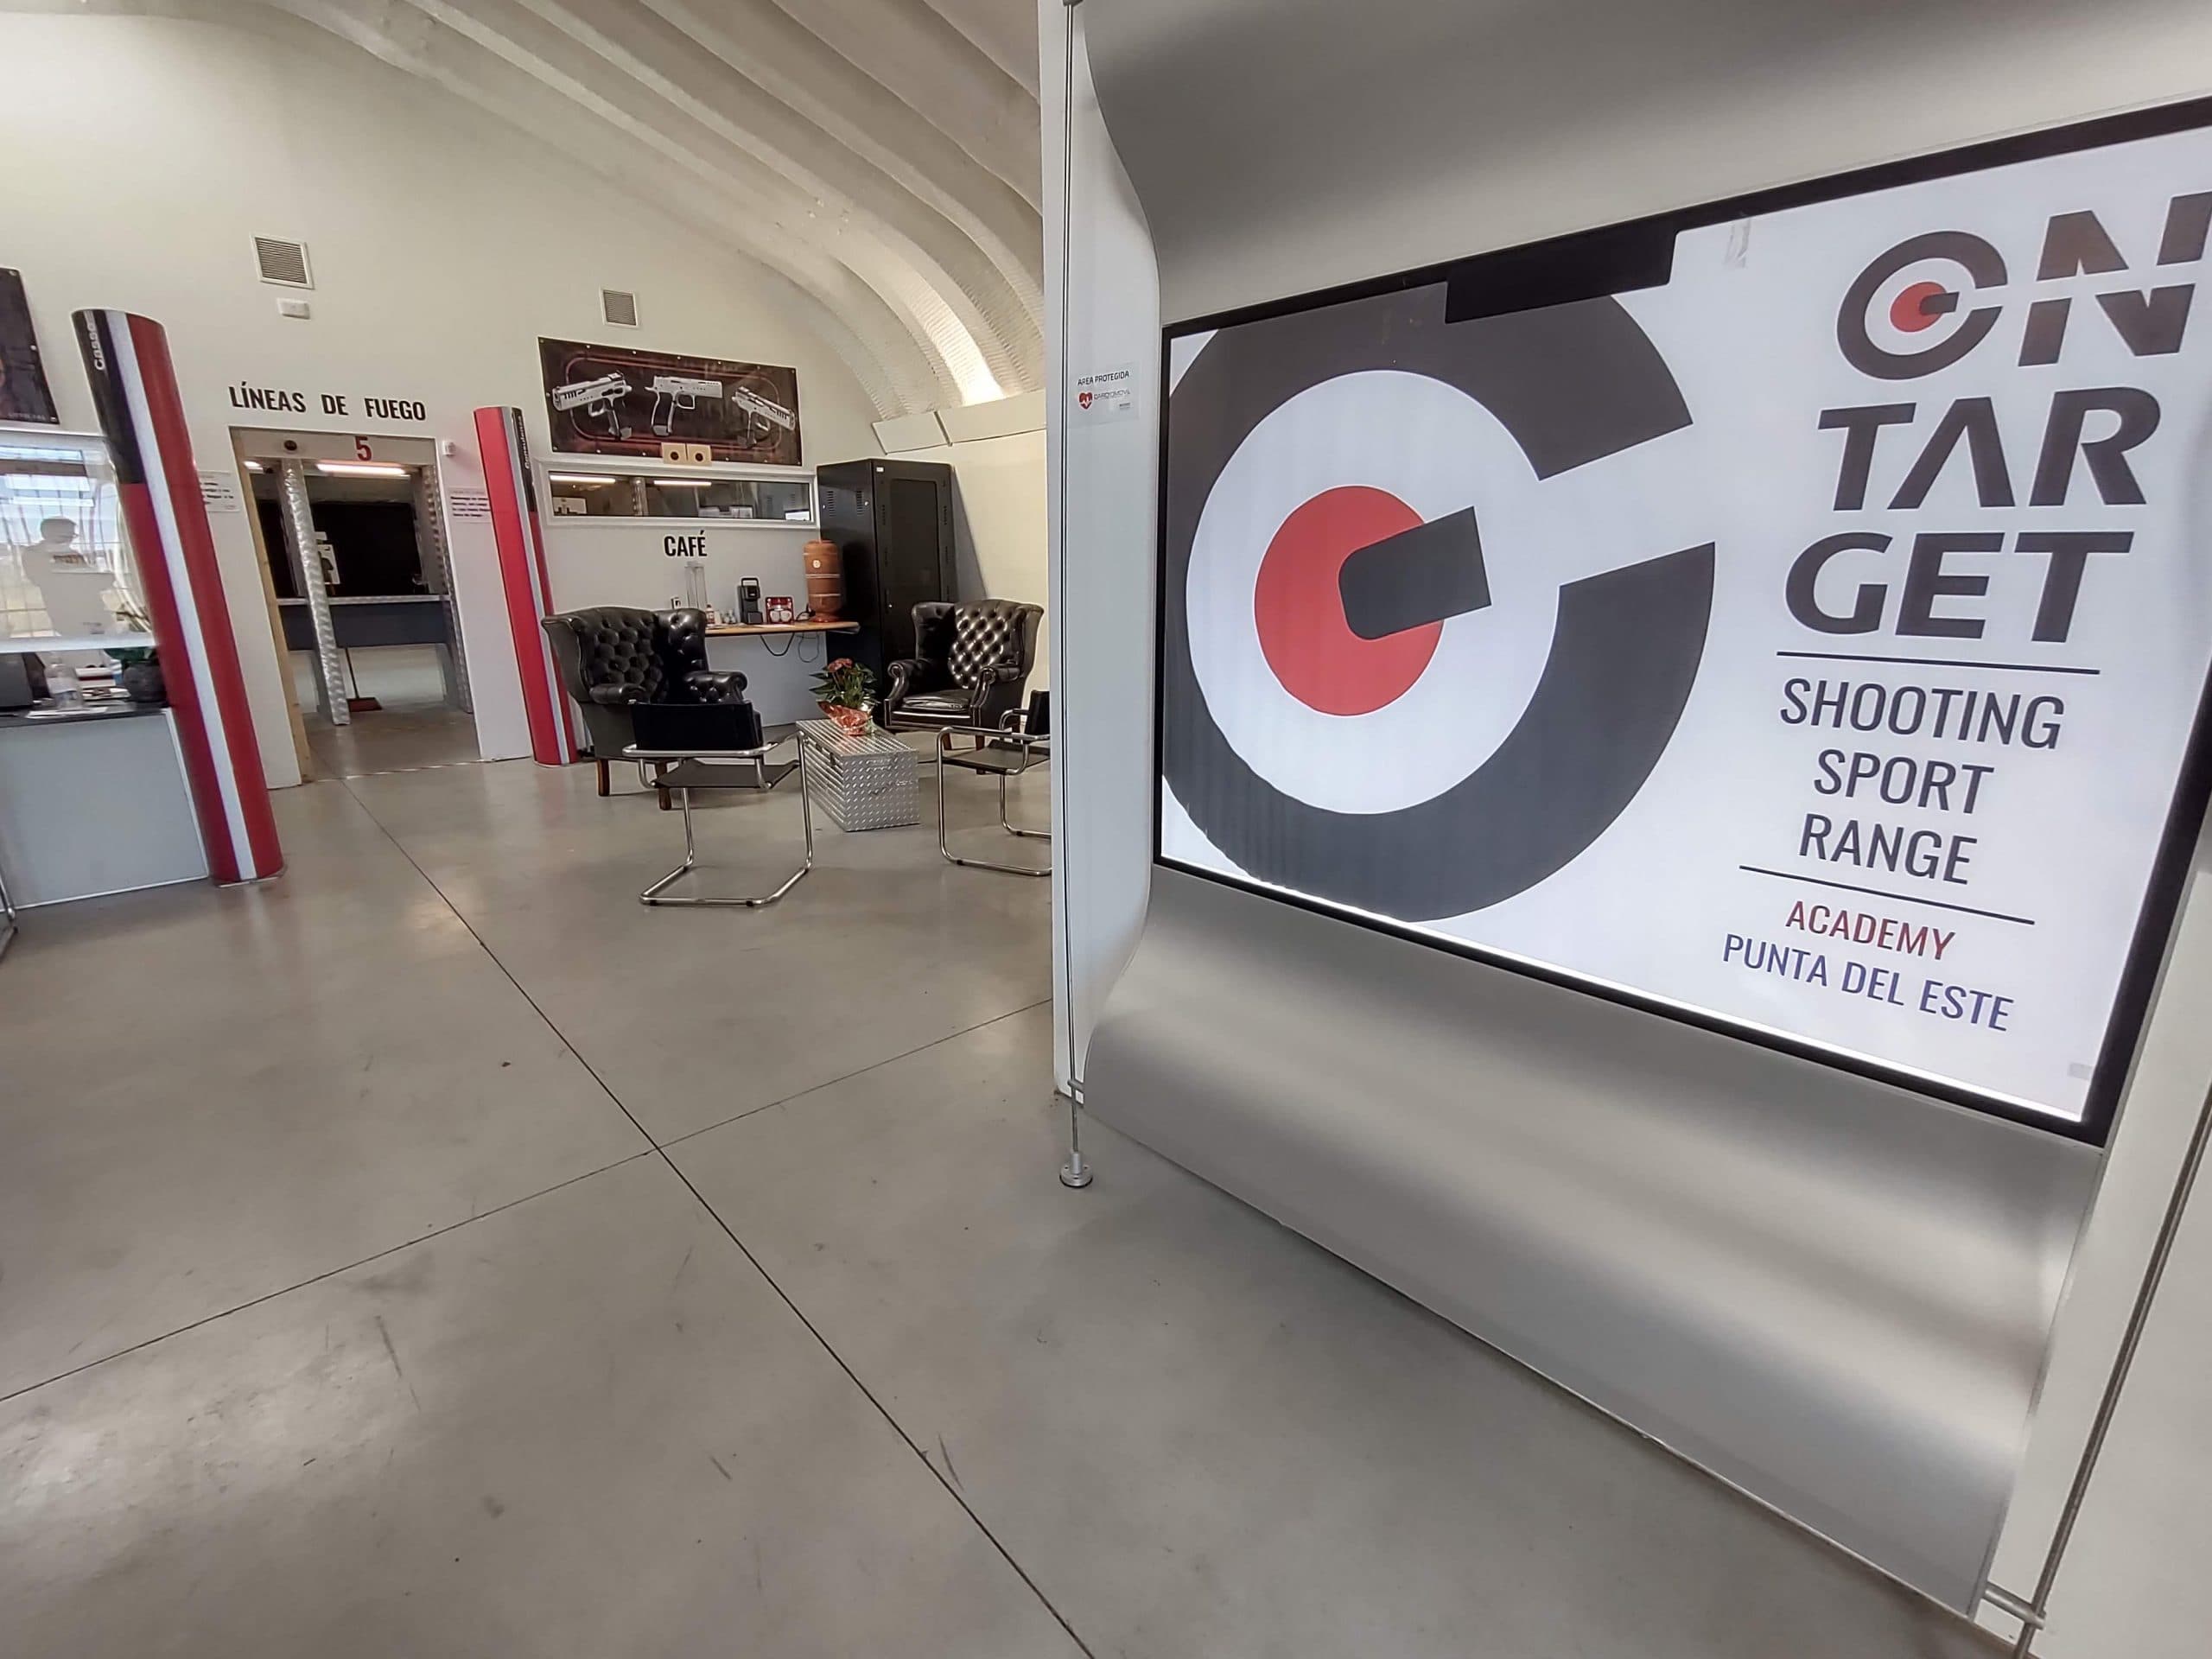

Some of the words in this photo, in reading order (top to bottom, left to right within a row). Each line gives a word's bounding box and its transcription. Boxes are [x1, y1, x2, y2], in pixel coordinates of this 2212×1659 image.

[1837, 190, 2212, 380] ON
[228, 381, 307, 413] LÍNEAS
[321, 394, 349, 416] DE
[364, 397, 426, 421] FUEGO
[1077, 376, 1094, 386] AREA
[1095, 370, 1130, 383] PROTEGIDA
[354, 435, 372, 461] 5
[1817, 386, 2161, 512] TAR
[664, 530, 708, 557] CAFÉ
[1784, 531, 2135, 643] GET
[1780, 677, 2065, 749] SHOOTING
[1813, 748, 1995, 814] SPORT
[1798, 813, 1978, 885] RANGE
[1785, 900, 1956, 961] ACADEMY
[1722, 933, 1827, 987] PUNTA
[1840, 961, 1904, 1007] DEL
[1918, 979, 2014, 1033] ESTE
